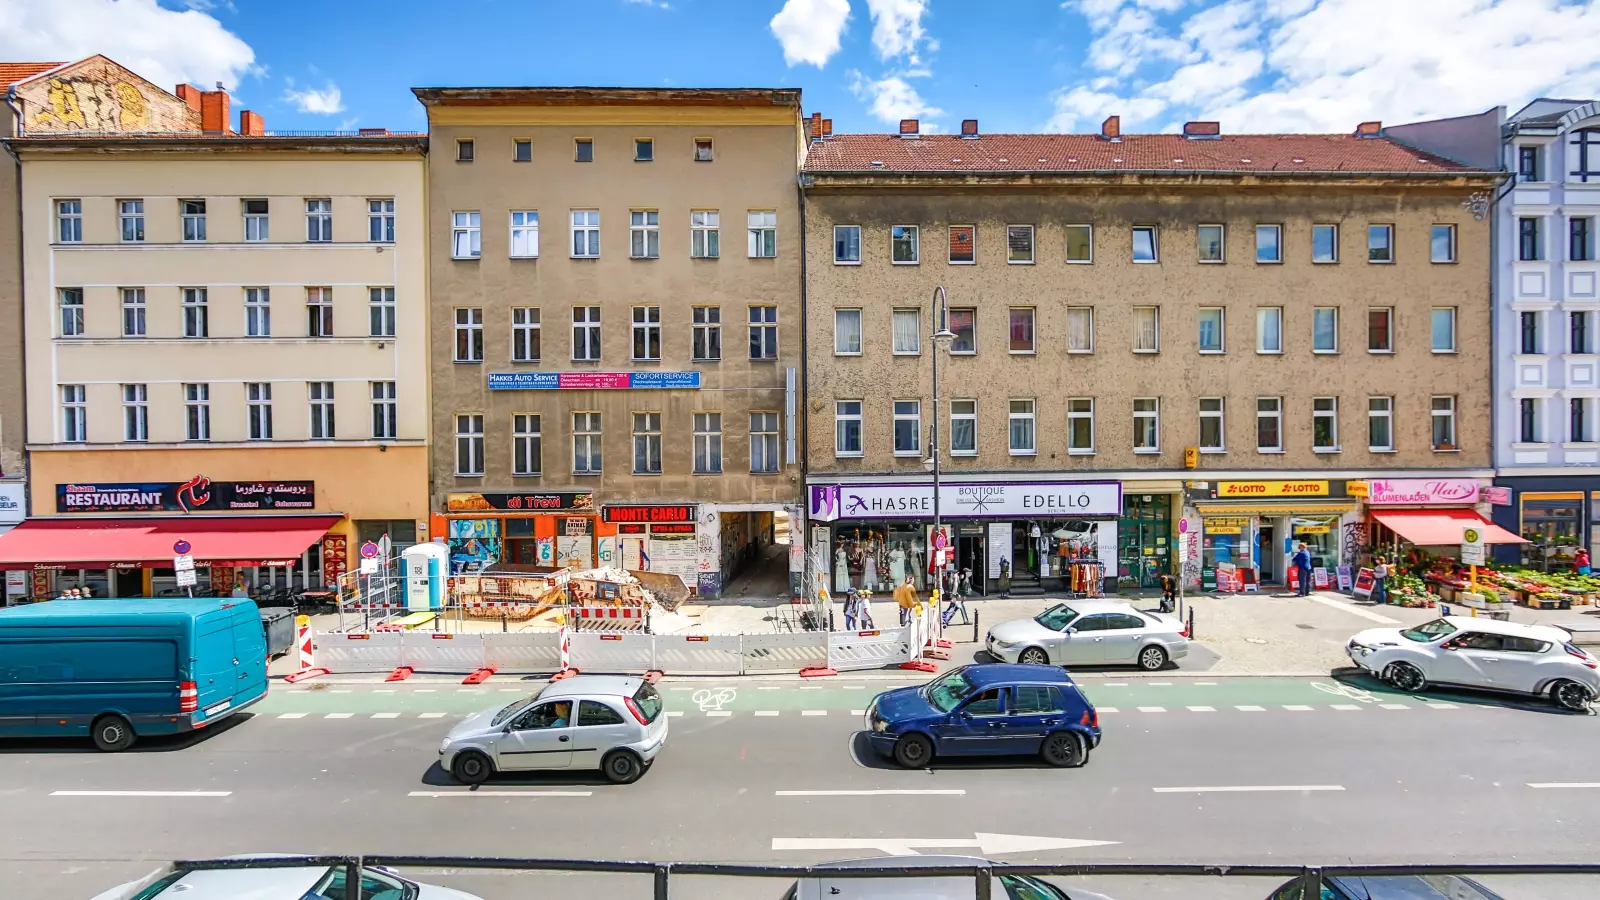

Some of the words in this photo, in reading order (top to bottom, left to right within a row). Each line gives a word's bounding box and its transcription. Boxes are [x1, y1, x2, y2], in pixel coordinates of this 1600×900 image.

[959, 487, 1004, 495] BOUTIQUE
[66, 493, 162, 506] RESTAURANT
[508, 496, 521, 508] di
[525, 496, 561, 508] Trevi
[872, 497, 941, 510] HASRE
[610, 508, 648, 520] MONTE
[651, 507, 687, 520] CARLO
